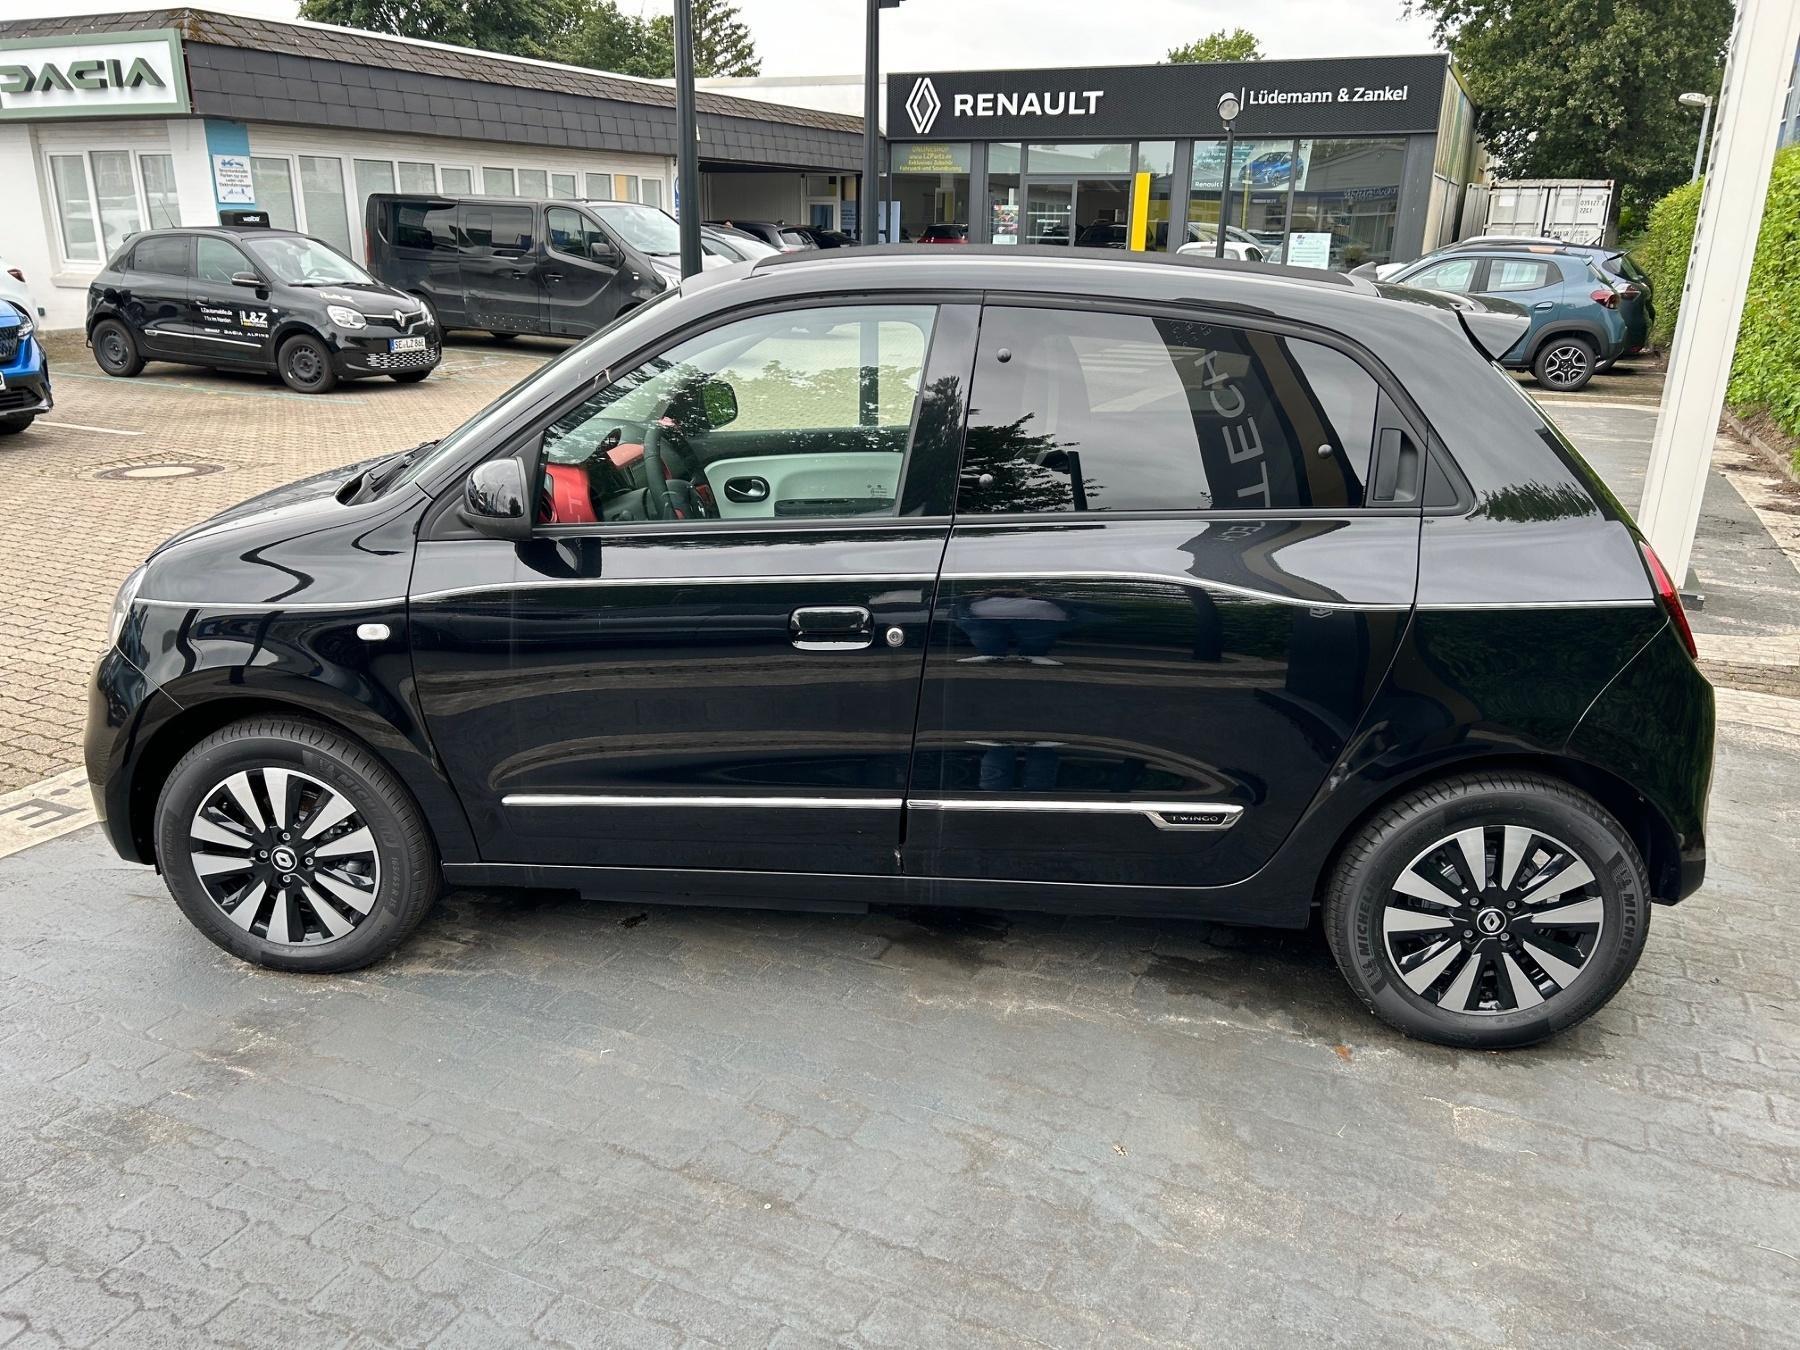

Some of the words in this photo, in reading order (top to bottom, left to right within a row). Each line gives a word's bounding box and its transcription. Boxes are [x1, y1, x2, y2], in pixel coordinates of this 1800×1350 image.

[0, 57, 166, 93] DACIA
[954, 91, 1104, 117] RENAULT
[1249, 89, 1332, 105] Lüdemann
[1337, 87, 1350, 103] &
[1352, 85, 1409, 102] Zankel
[241, 310, 268, 323] L&Z
